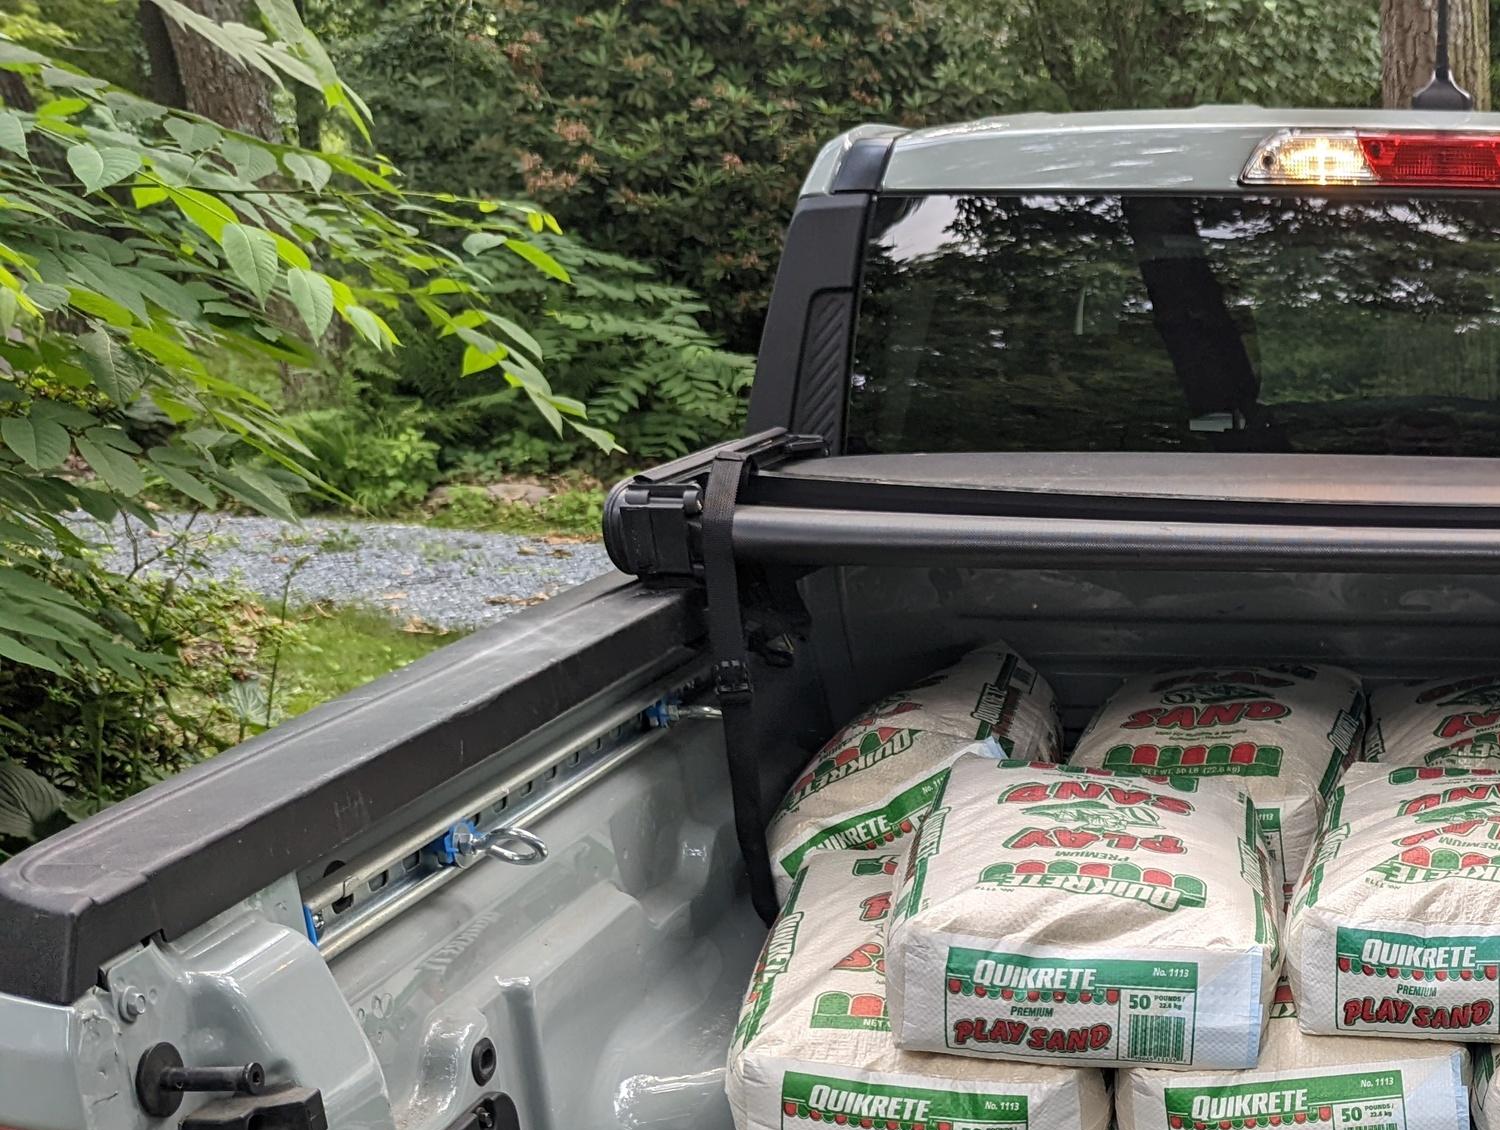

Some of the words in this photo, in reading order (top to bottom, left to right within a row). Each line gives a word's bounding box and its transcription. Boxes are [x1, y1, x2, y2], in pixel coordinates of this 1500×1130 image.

[1120, 702, 1292, 730] SAND
[998, 780, 1194, 816] SAND
[1003, 827, 1188, 855] PLAY
[1055, 850, 1130, 862] PREMIUM
[1003, 872, 1182, 912] QUIKRETE
[1362, 939, 1476, 969] QUIKRETE
[973, 960, 1096, 990] QUIKRETE
[1153, 967, 1166, 977] No.
[1169, 968, 1189, 978] 1113
[1129, 995, 1150, 1009] 50
[1397, 984, 1437, 997] PREMIUM
[1010, 1005, 1054, 1017] PREMIUM
[1344, 996, 1413, 1026] PLAY
[1413, 999, 1494, 1029] SAND
[954, 1018, 1028, 1044] PLAY
[1027, 1022, 1112, 1053] SAND
[1360, 1079, 1373, 1088] No.
[1375, 1077, 1394, 1086] 1113
[808, 1085, 931, 1122] QUIKRETE
[984, 1101, 998, 1110] No.
[1000, 1102, 1019, 1111] 1113
[1191, 1089, 1307, 1121] QUIKRETE
[1342, 1106, 1362, 1122] 50
